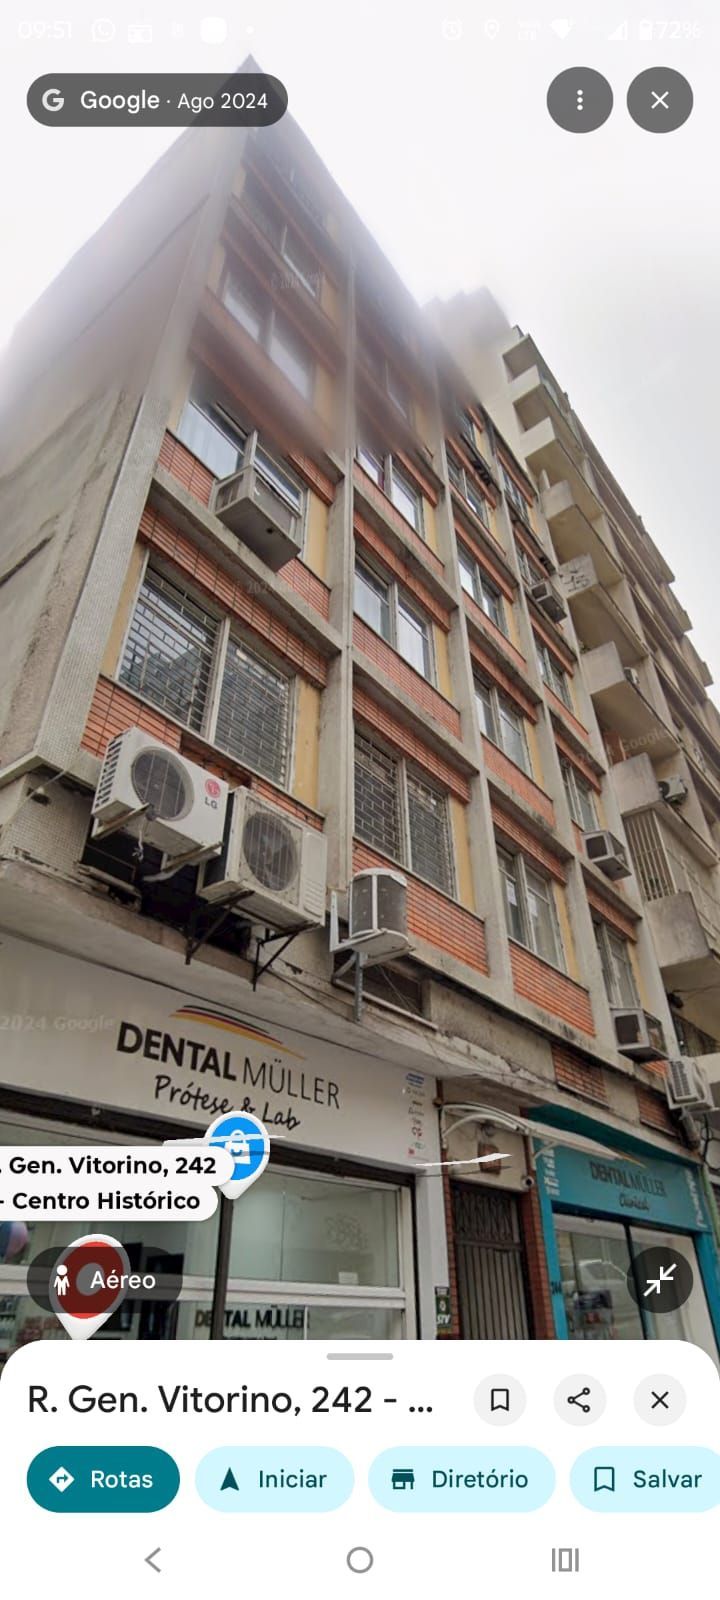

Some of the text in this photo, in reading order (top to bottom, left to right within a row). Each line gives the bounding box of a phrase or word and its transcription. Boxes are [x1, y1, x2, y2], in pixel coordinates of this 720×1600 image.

[204, 796, 218, 810] LG
[116, 1021, 341, 1110] DENTAL MÜLLER
[154, 1073, 301, 1131] Prótese & Lab
[589, 1160, 631, 1190] DENTAL
[195, 1309, 250, 1328] DETAL
